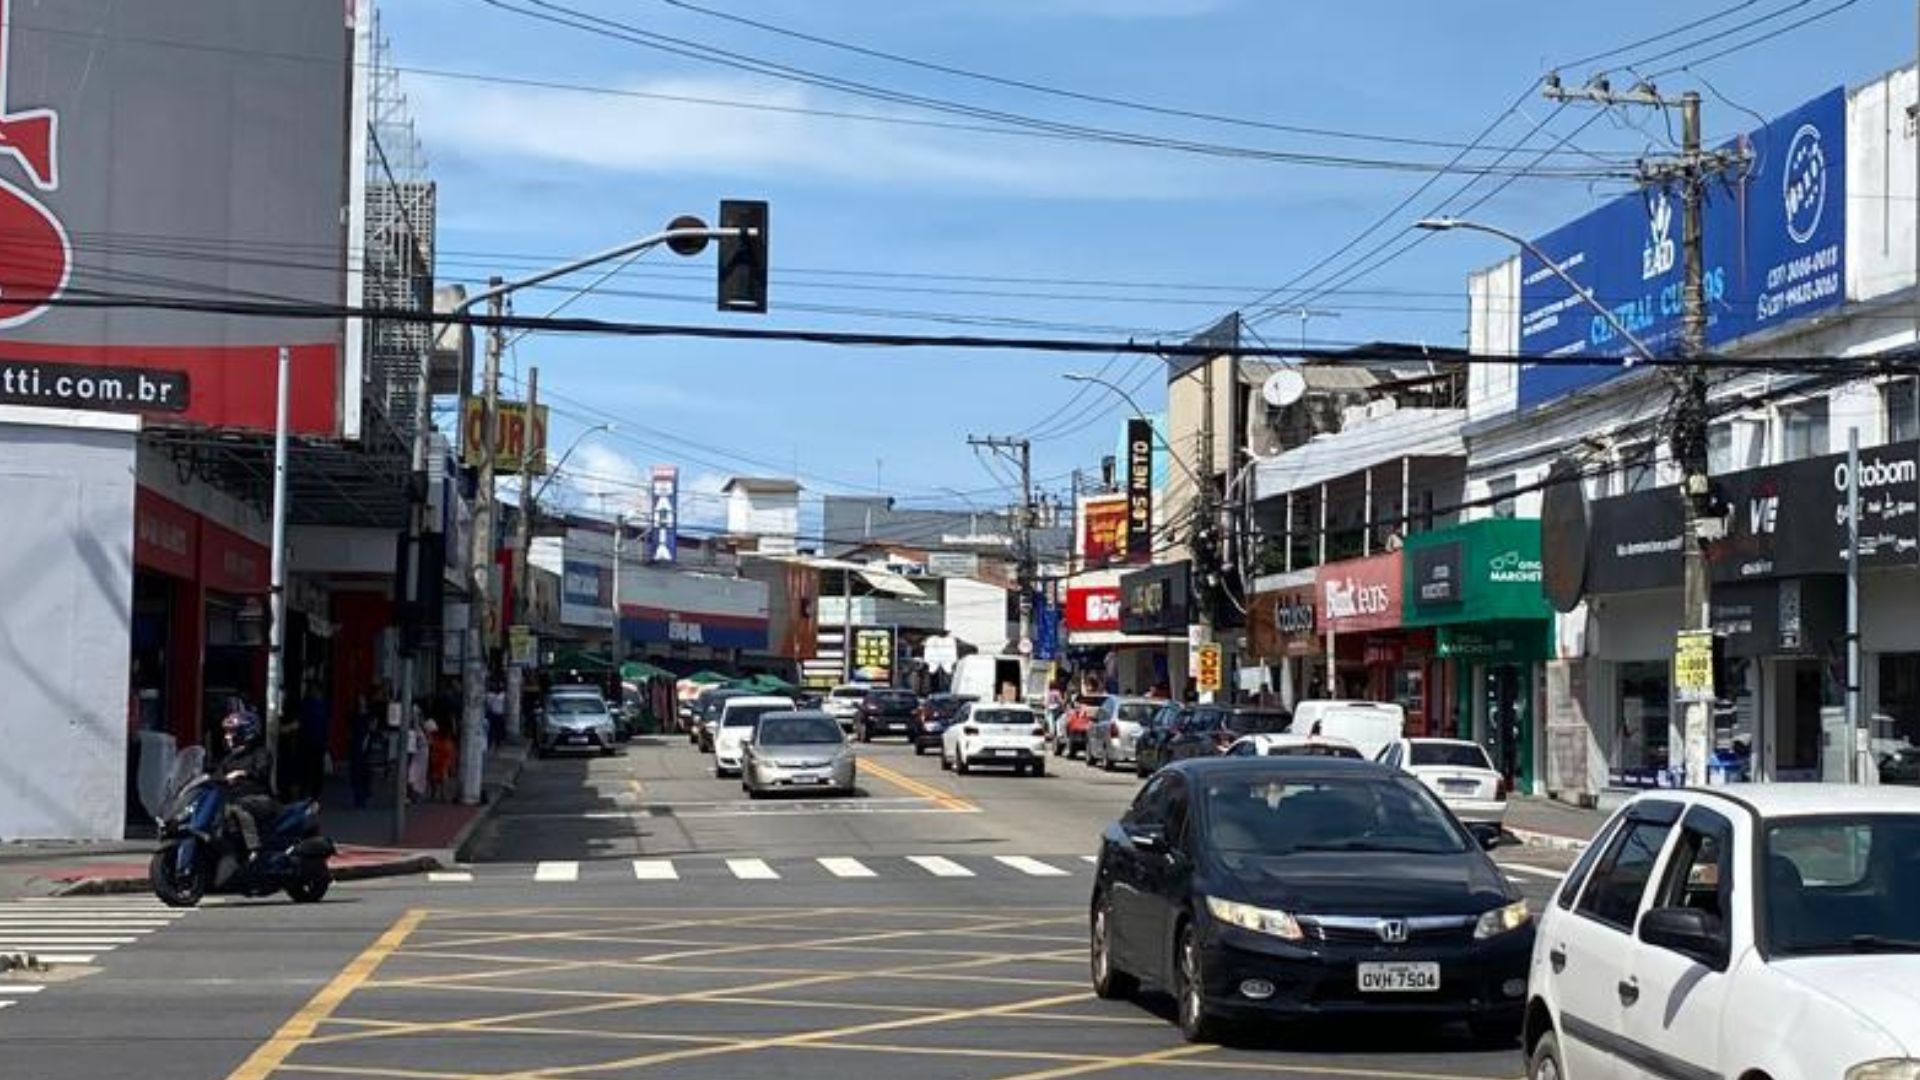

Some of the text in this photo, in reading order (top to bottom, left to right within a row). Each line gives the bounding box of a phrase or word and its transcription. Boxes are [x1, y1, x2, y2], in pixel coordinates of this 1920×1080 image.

[3, 367, 172, 402] tti.com.br
[1132, 440, 1148, 490] NETO
[1834, 457, 1916, 491] Otobom
